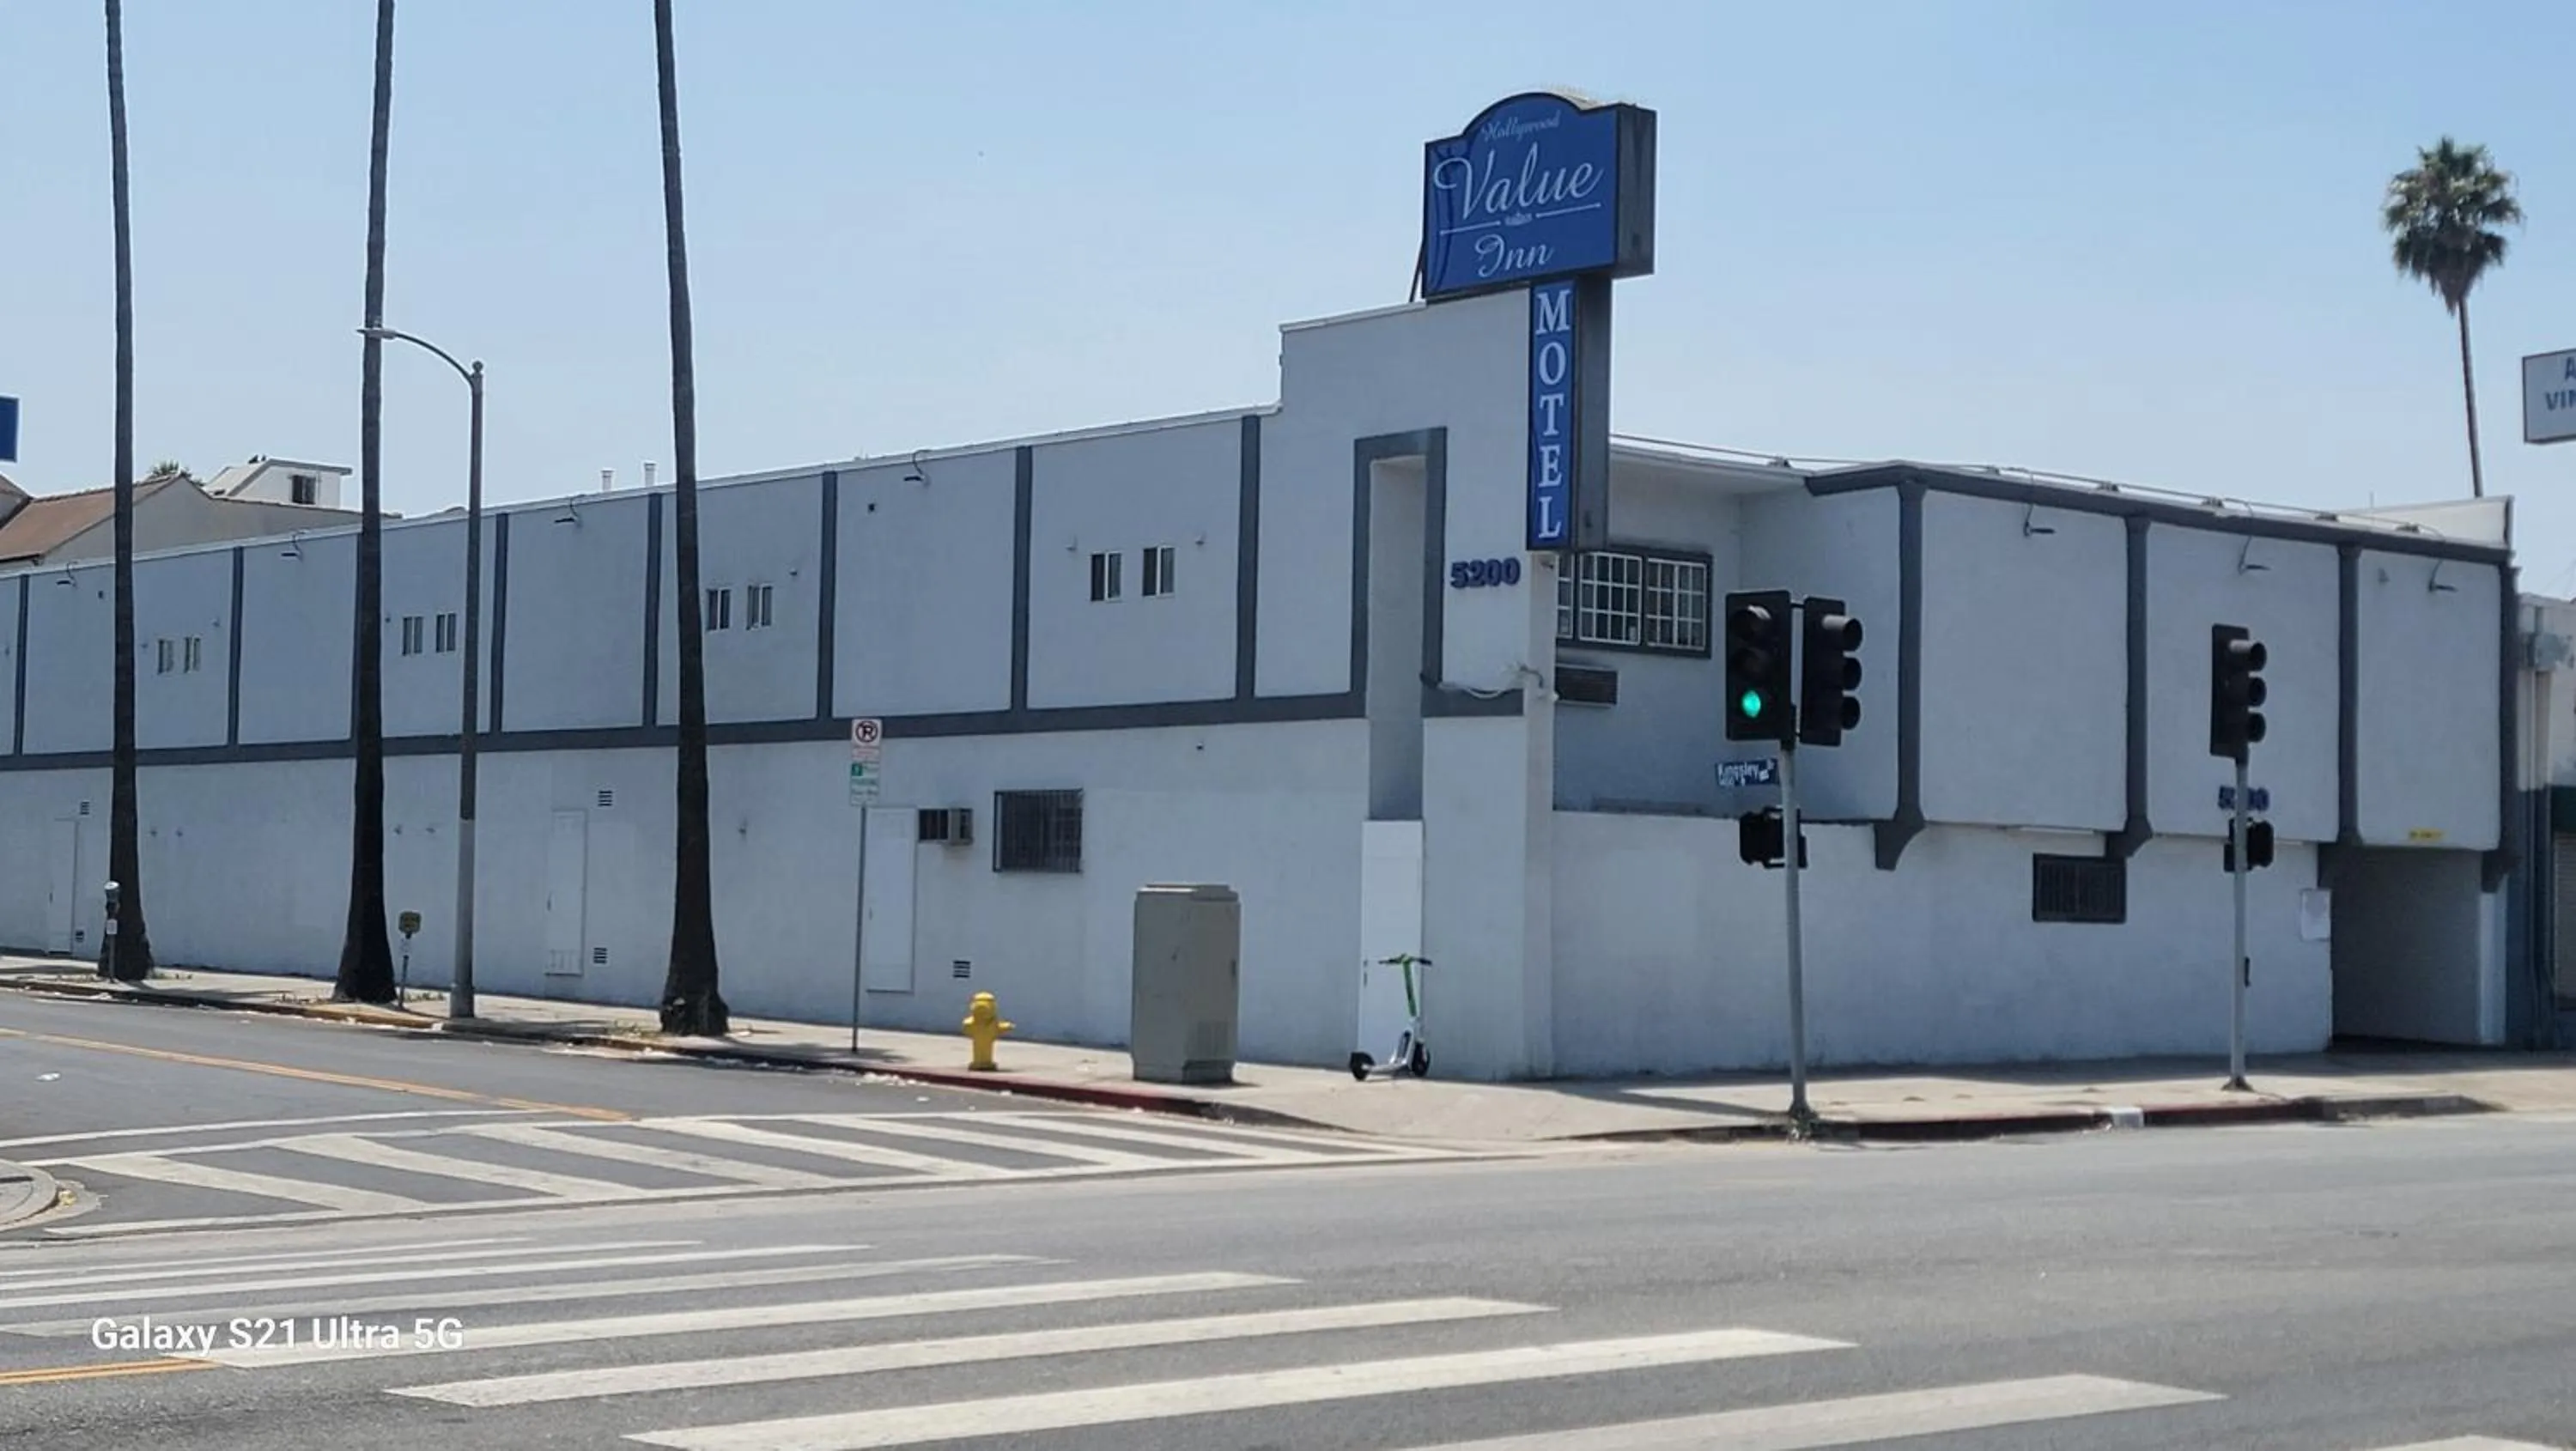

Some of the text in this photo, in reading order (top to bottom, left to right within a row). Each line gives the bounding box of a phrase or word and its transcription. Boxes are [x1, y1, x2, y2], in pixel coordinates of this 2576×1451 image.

[1479, 109, 1561, 143] Hollywood
[1433, 142, 1604, 220] Value
[1475, 234, 1555, 277] Inn
[1534, 288, 1571, 538] MOTEL
[1450, 558, 1521, 589] 5200
